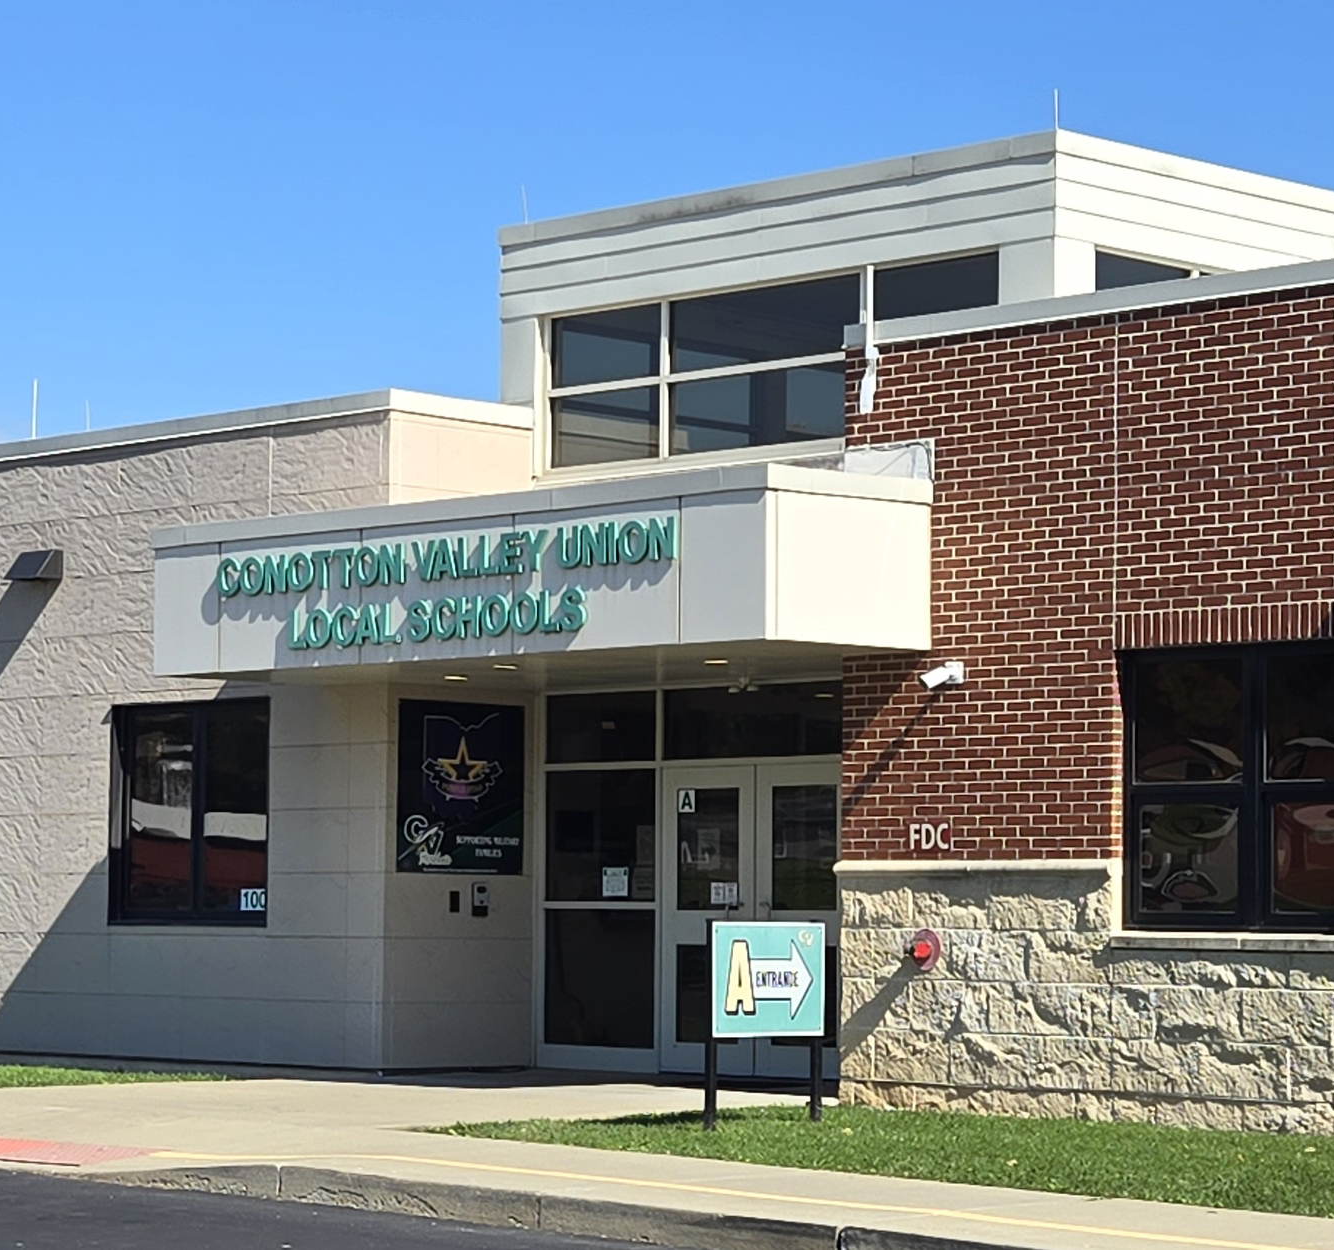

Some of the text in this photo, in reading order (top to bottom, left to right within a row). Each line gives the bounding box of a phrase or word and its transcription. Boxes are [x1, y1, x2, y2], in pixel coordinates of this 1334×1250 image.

[217, 516, 677, 597] CONOTTON VALLEY UNION
[288, 585, 588, 650] LOCAL SCHOOLS
[681, 791, 693, 810] A
[909, 822, 949, 850] FDC
[724, 939, 799, 1016] A ENTRANCE
